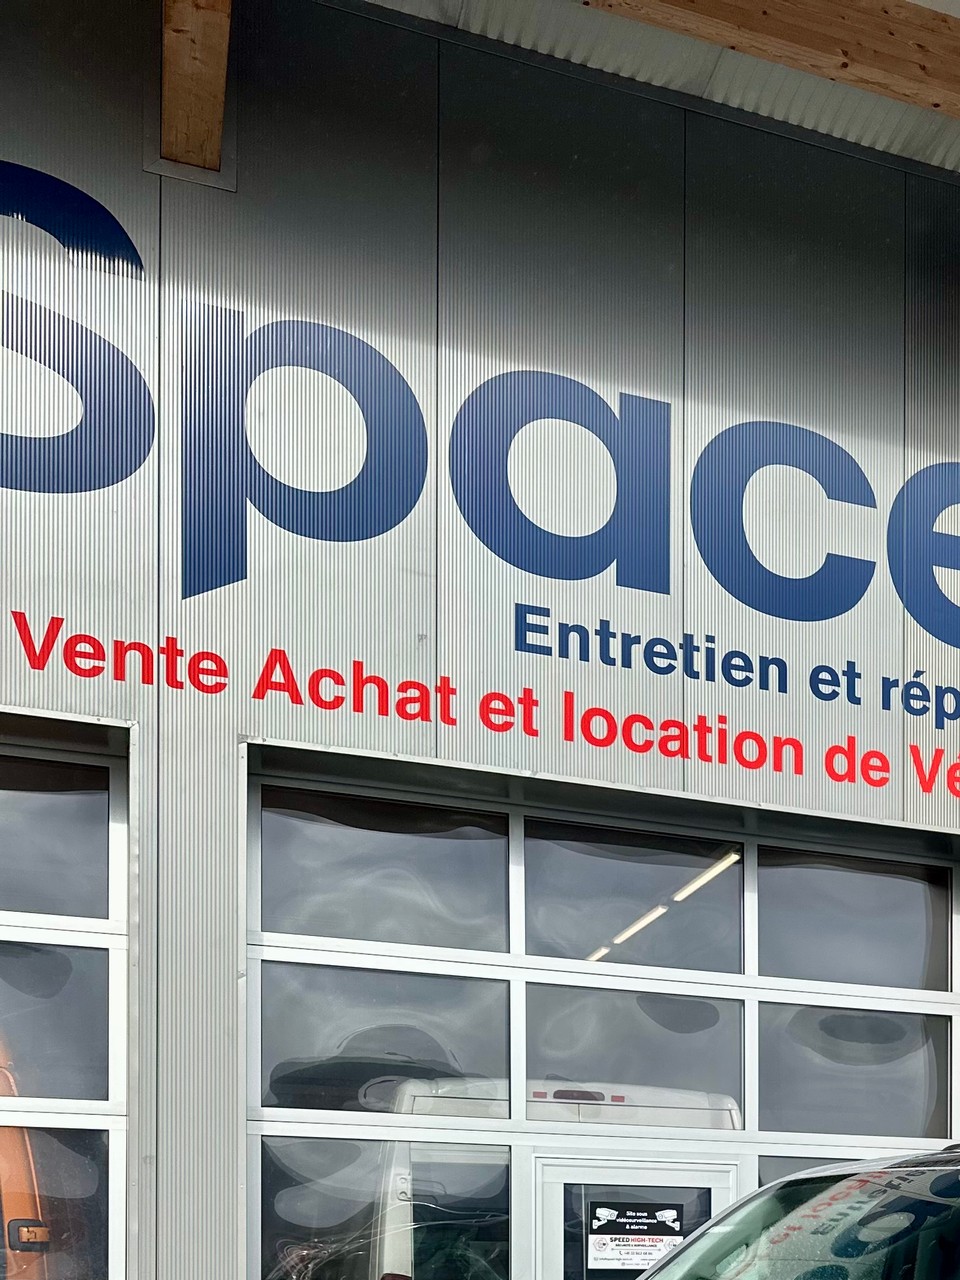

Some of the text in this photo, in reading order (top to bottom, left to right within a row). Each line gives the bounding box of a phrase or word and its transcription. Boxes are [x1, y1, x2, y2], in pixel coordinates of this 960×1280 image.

[11, 610, 229, 695] Vente
[252, 648, 457, 726] Achat
[479, 687, 539, 737] et
[563, 690, 804, 776] location
[824, 735, 891, 788] de
[515, 604, 788, 694] Entretien
[809, 661, 862, 706] et
